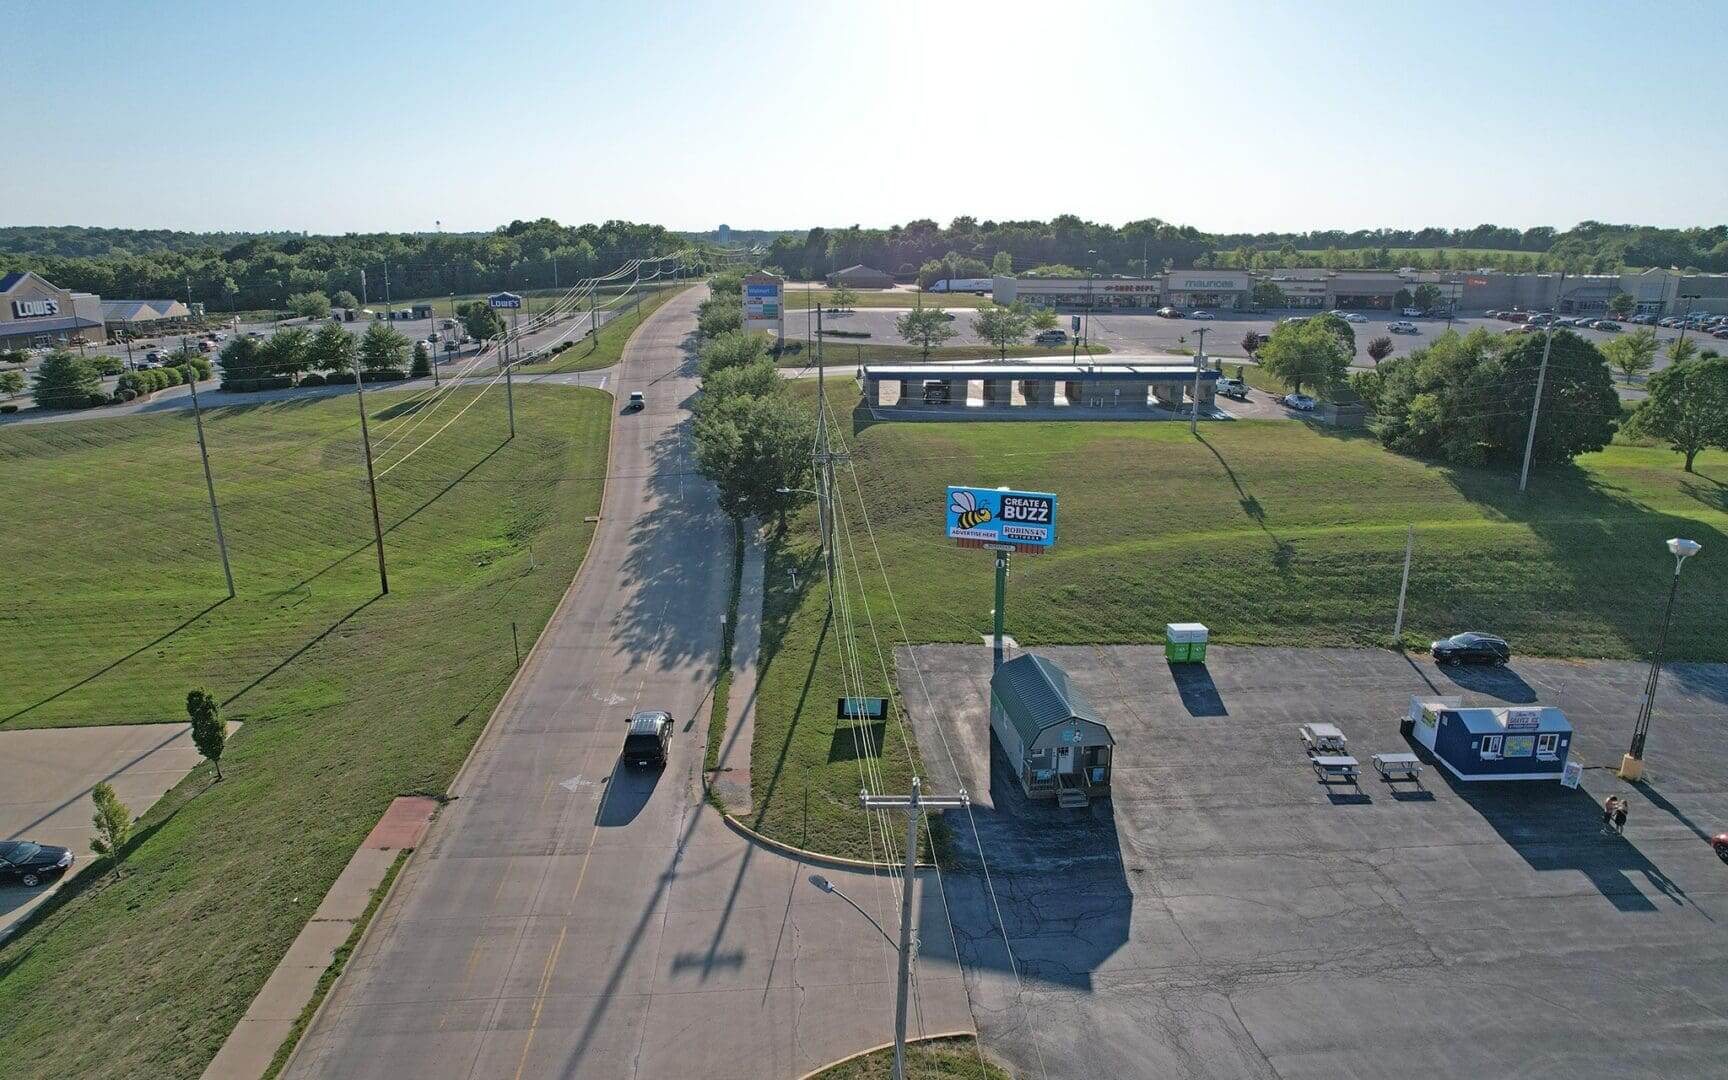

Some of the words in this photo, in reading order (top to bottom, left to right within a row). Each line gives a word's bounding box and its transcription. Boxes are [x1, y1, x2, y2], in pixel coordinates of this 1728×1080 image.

[1004, 497, 1040, 507] CREATE
[1040, 500, 1048, 508] A
[1004, 505, 1049, 521] BUZZ
[952, 529, 981, 537] ADVERTISE
